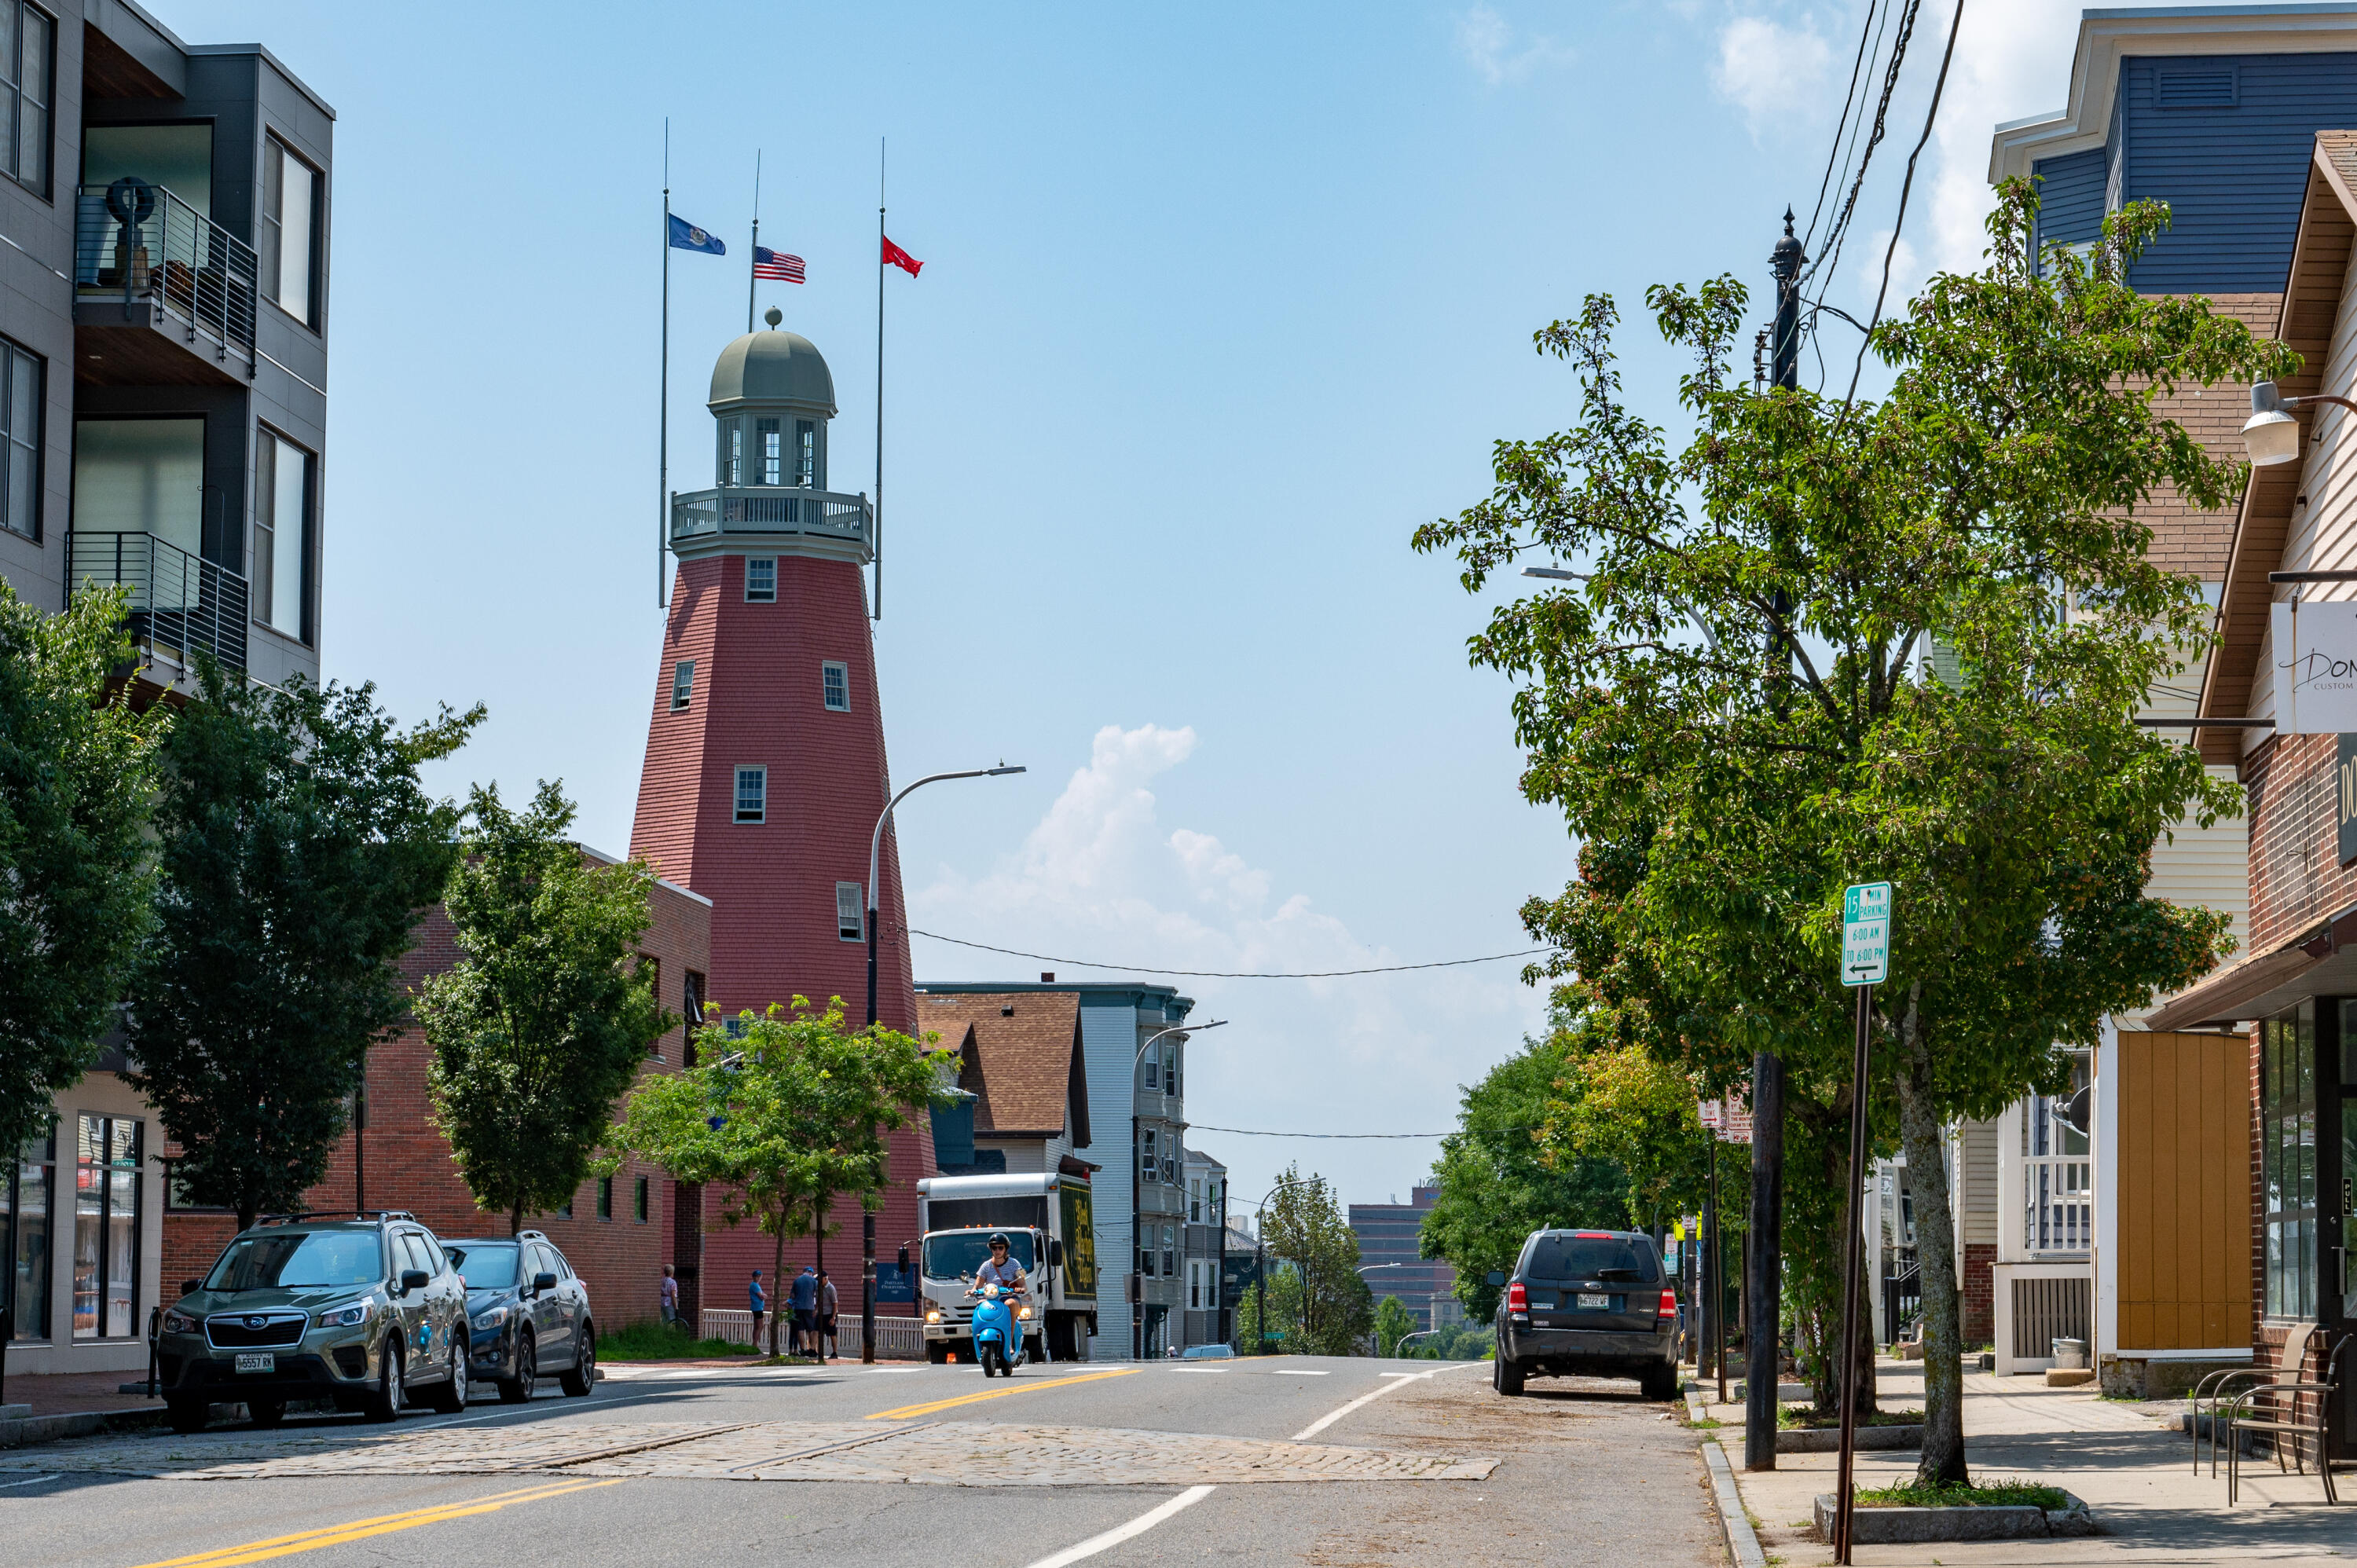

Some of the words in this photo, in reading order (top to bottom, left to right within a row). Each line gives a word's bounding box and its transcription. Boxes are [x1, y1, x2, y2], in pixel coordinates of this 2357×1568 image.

[2341, 755, 2357, 826] DO
[1869, 889, 1881, 901] MIN
[1848, 896, 1858, 914] 15
[1860, 903, 1886, 918] PARKING
[1853, 929, 1868, 941] 6:00
[1870, 927, 1879, 939] AM
[1846, 951, 1854, 962] TO
[1857, 948, 1872, 962] 6:00
[1875, 947, 1883, 959] PM
[243, 1357, 261, 1368] 5557
[262, 1357, 272, 1367] RK
